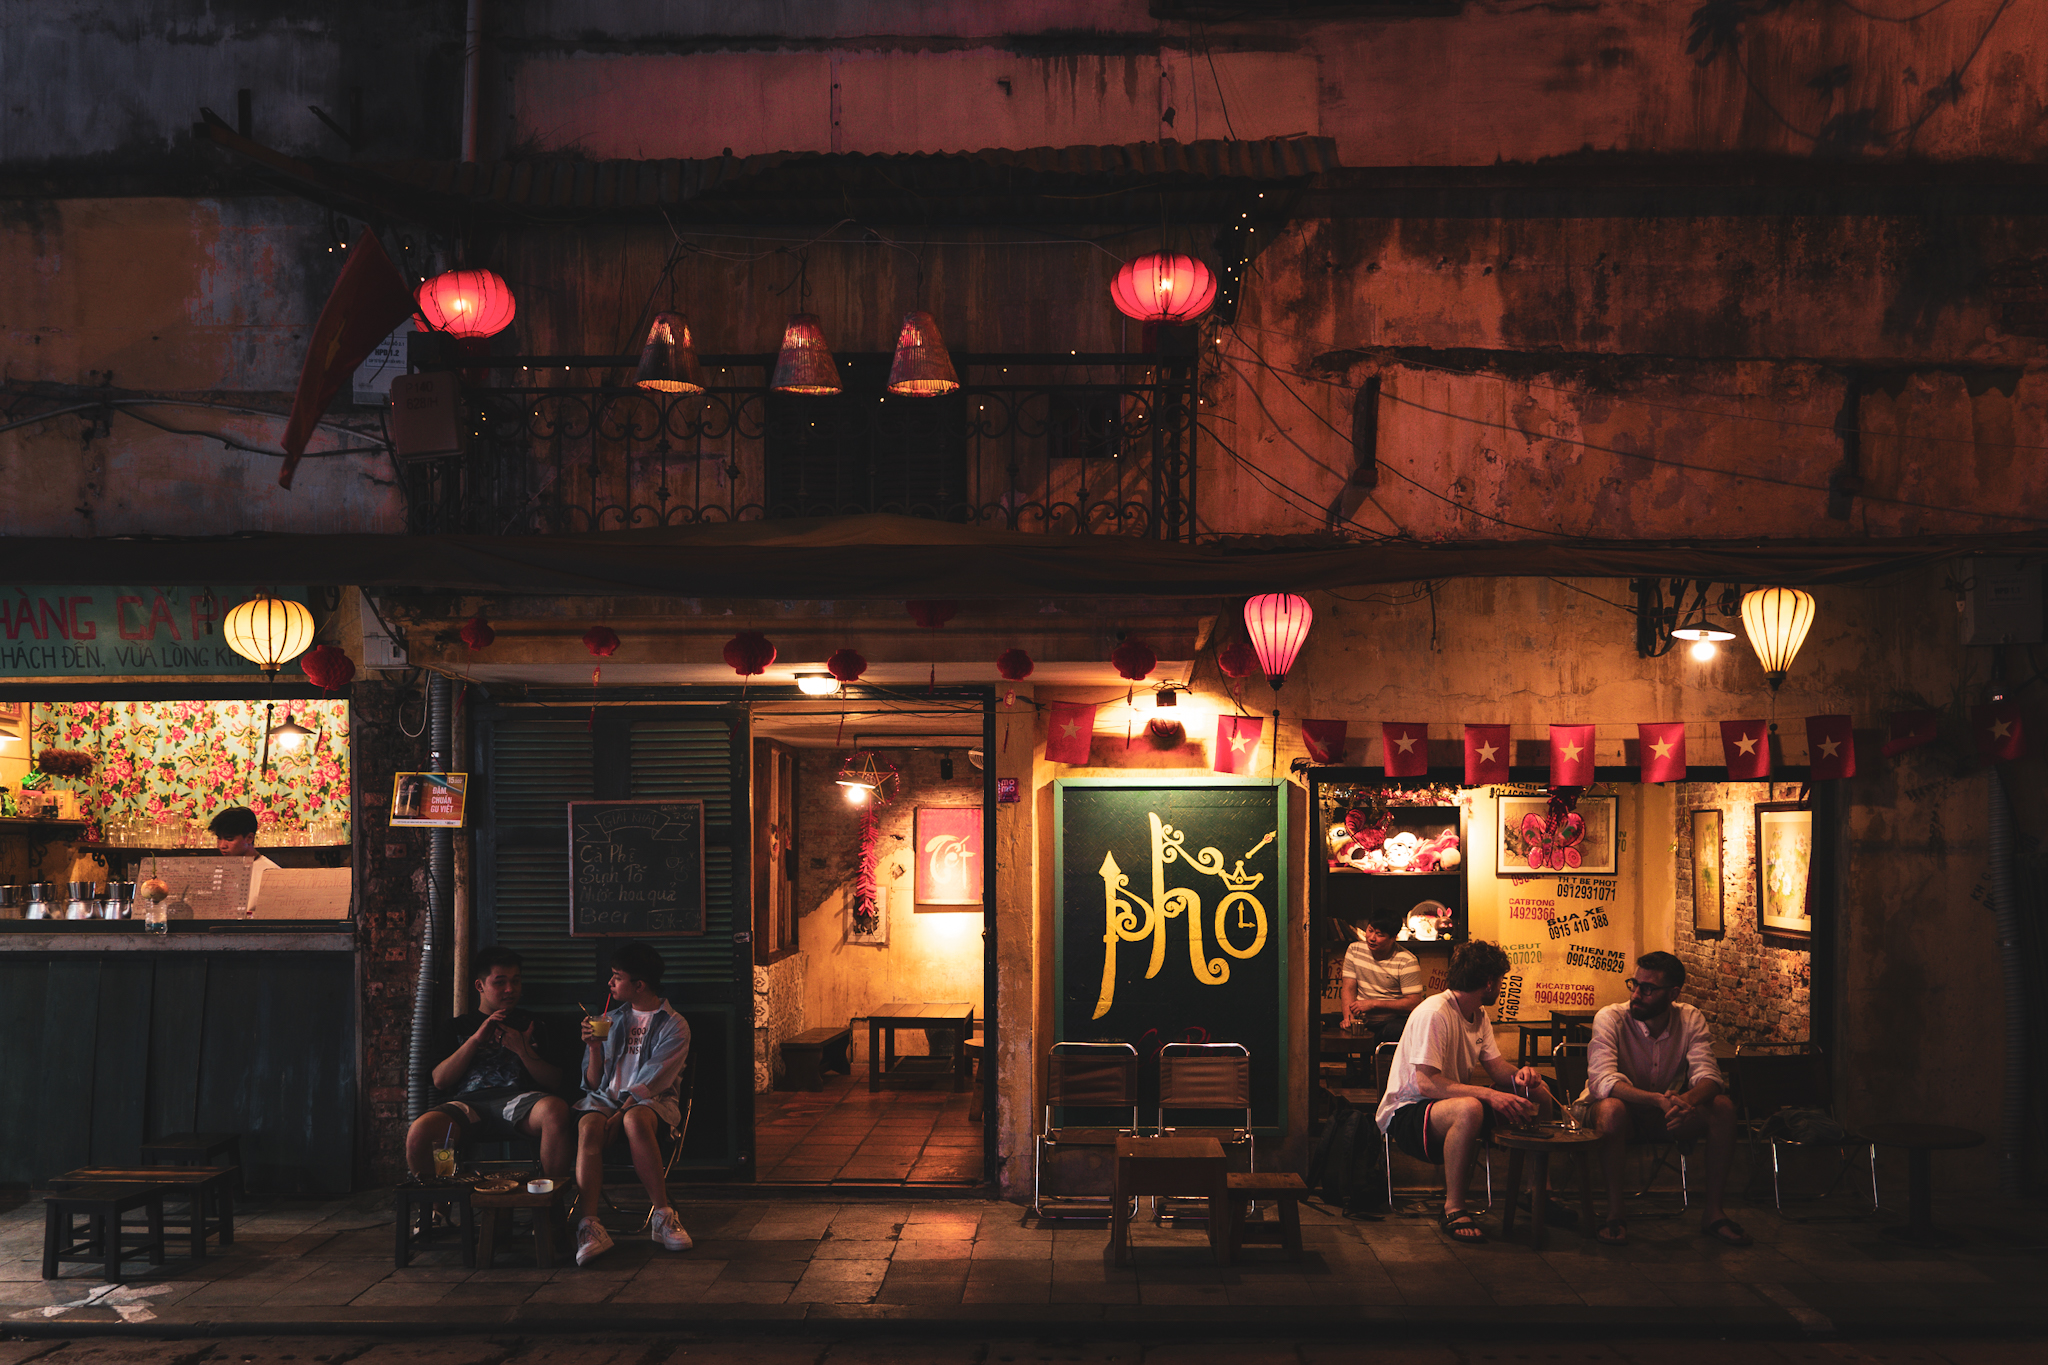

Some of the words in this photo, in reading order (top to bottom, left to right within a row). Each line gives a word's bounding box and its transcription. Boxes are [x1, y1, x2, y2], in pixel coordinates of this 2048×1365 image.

[116, 585, 181, 640] CÀ
[0, 641, 56, 669] HÁCH
[163, 642, 208, 668] LÒNG
[430, 805, 440, 813] GU
[1579, 878, 1591, 886] BE
[1593, 879, 1617, 888] PHOT
[1557, 884, 1616, 901] 0912931071
[1509, 898, 1555, 906] CATBTONG
[579, 906, 631, 925] Beer
[1584, 906, 1605, 917] XE
[1549, 924, 1571, 940] 0915
[1574, 919, 1590, 933] 410
[1591, 914, 1609, 929] 388
[1569, 944, 1604, 956] THIEN
[1608, 950, 1626, 960] ME
[1567, 951, 1625, 974] 0904366929
[1534, 990, 1595, 1006] 0904929366
[631, 1027, 647, 1036] GOO
